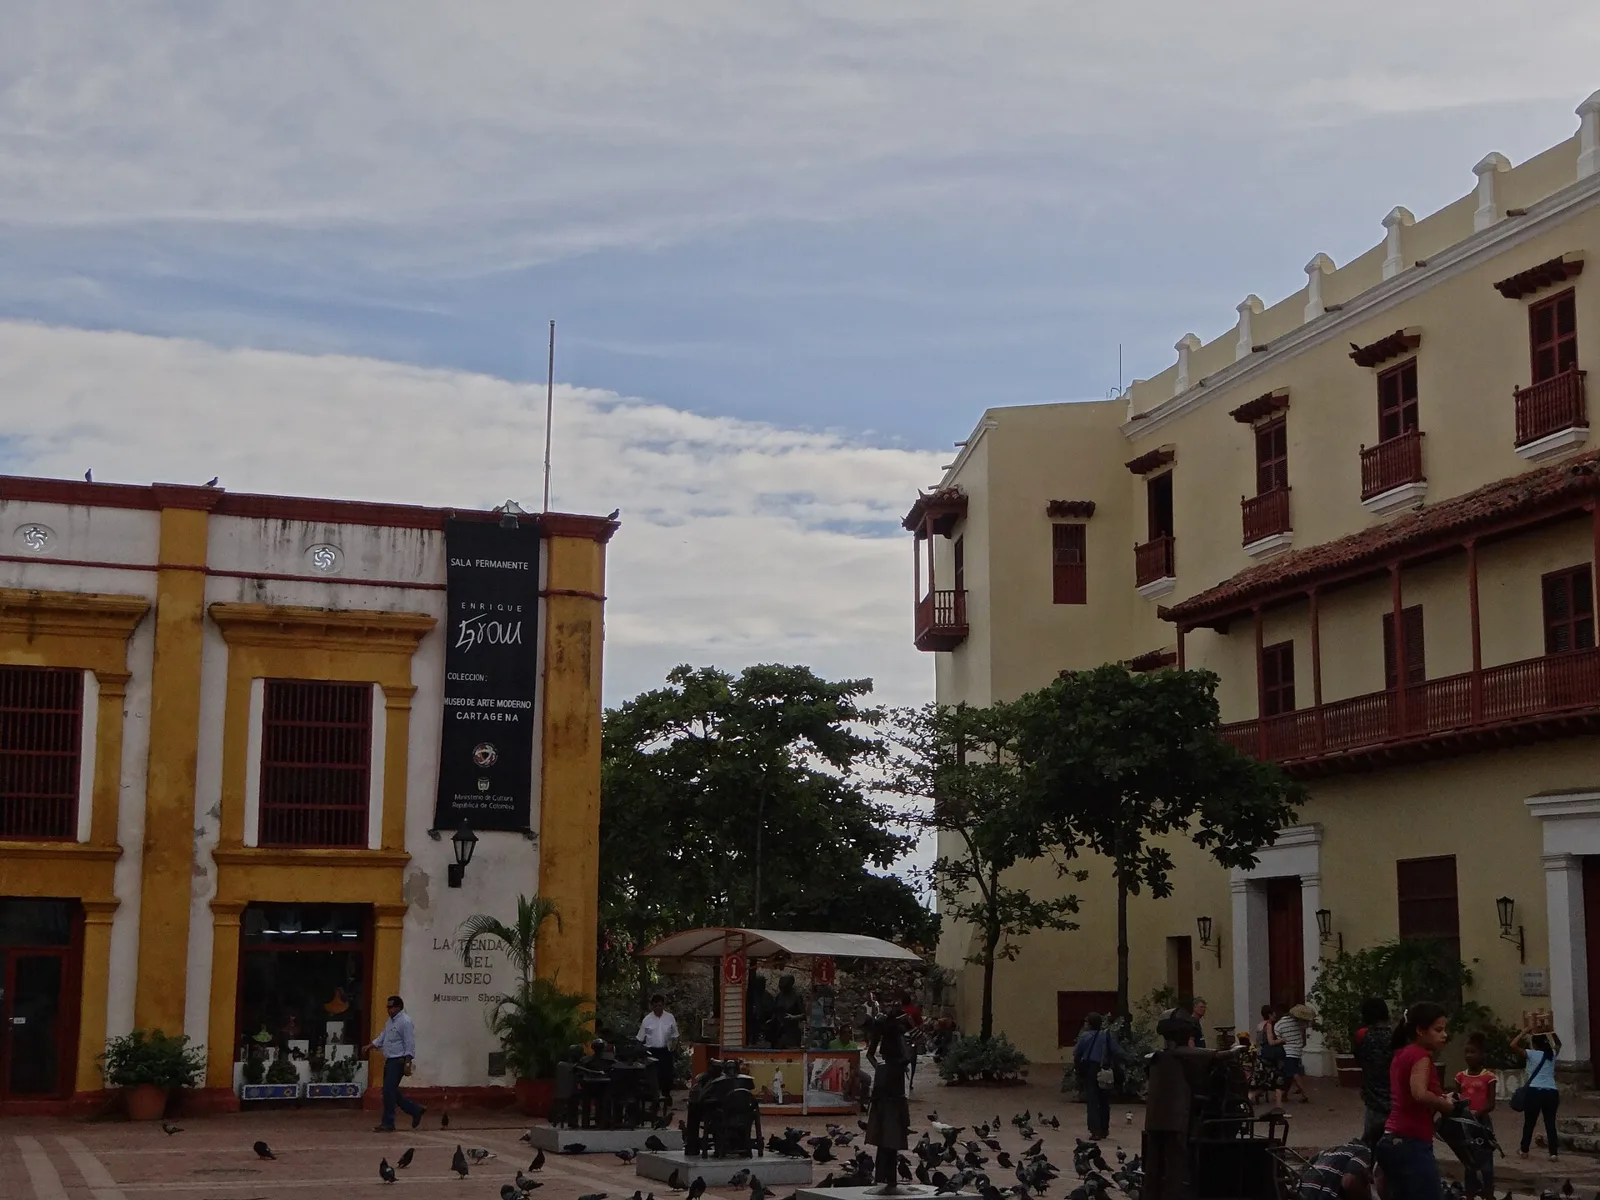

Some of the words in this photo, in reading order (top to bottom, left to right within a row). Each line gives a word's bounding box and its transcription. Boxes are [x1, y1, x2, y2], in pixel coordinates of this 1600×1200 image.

[450, 557, 472, 567] SALA
[475, 559, 529, 570] PERMANENTE
[461, 602, 522, 612] ENRIQUE
[444, 697, 466, 706] MUSEO
[476, 699, 495, 707] ARTE
[496, 700, 532, 709] MODERNO
[456, 711, 519, 722] CARTAGENA
[433, 938, 451, 950] LA
[458, 938, 504, 951] TENDA
[443, 972, 492, 985] MUSEO
[433, 993, 469, 1003] Museum
[477, 993, 502, 1003] Shop
